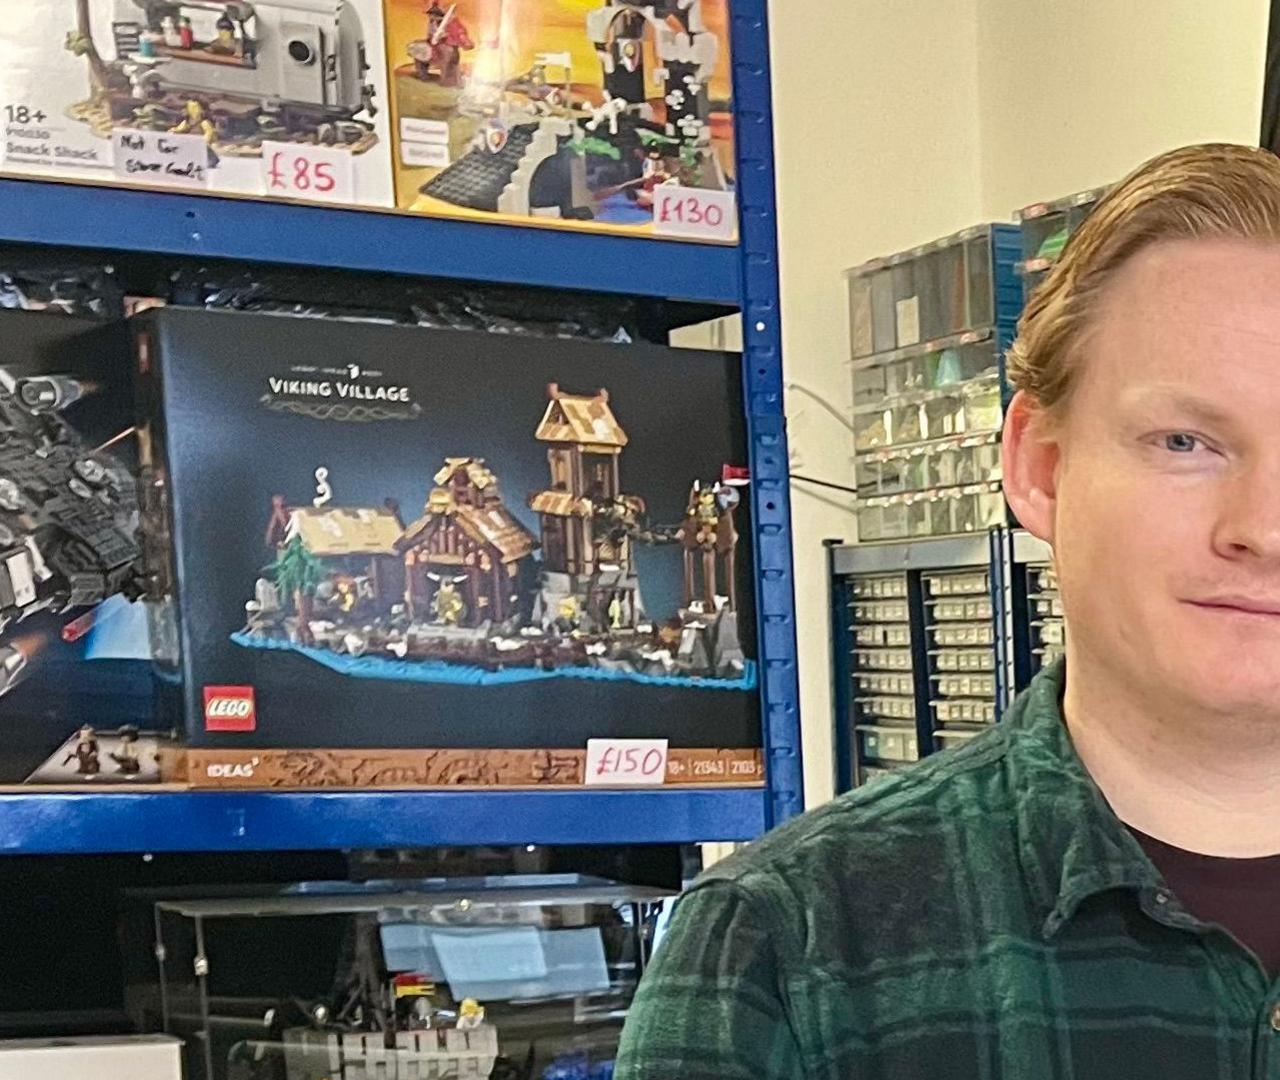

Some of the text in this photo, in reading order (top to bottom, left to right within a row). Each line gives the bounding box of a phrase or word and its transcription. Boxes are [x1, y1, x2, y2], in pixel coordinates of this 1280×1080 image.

[5, 105, 47, 124] 18+
[268, 153, 337, 192] £85
[658, 196, 724, 228] £130
[268, 376, 410, 402] VIKING VILLAGE
[208, 700, 250, 716] LEGO
[207, 763, 254, 777] IDEAS
[596, 747, 663, 776] £150
